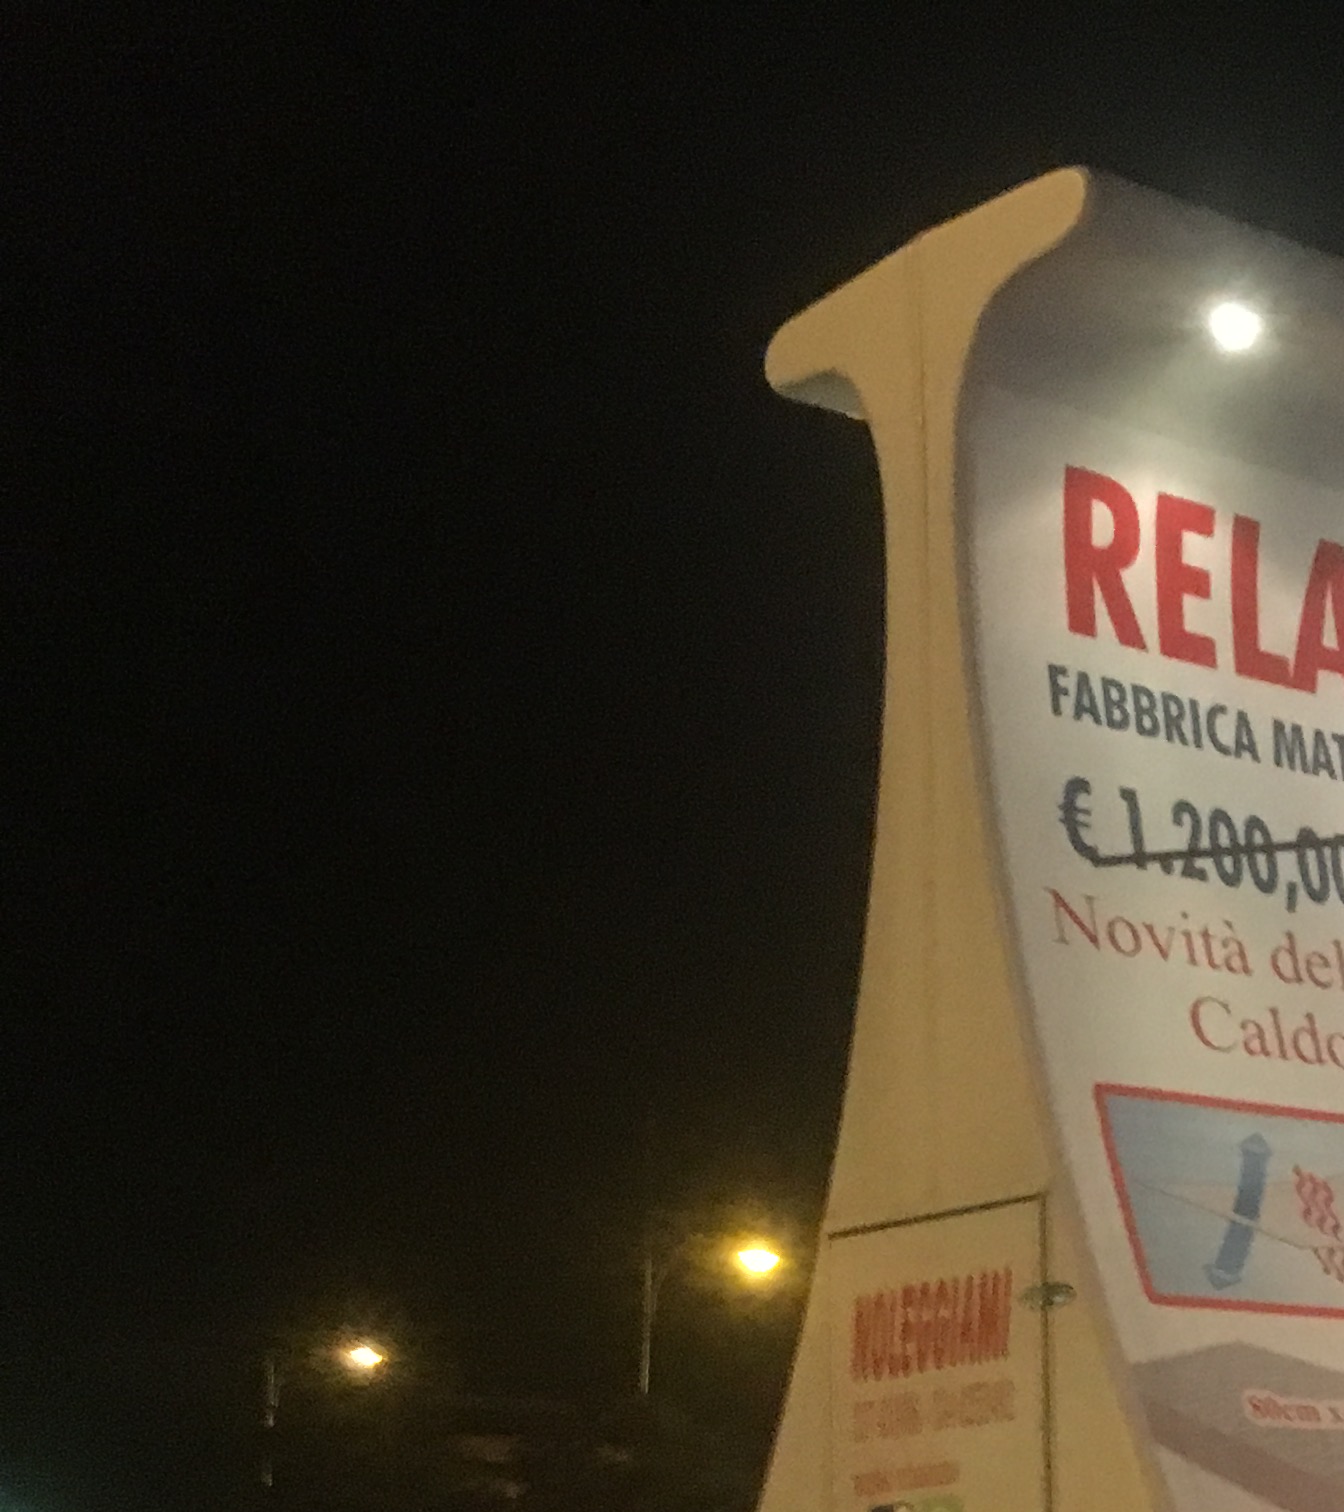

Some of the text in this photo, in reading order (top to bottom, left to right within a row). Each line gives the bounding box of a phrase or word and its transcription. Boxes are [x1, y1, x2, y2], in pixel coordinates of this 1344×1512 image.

[1047, 663, 1261, 763] FABBRICA
[1060, 776, 1103, 867] €
[1045, 887, 1253, 977] Novità
